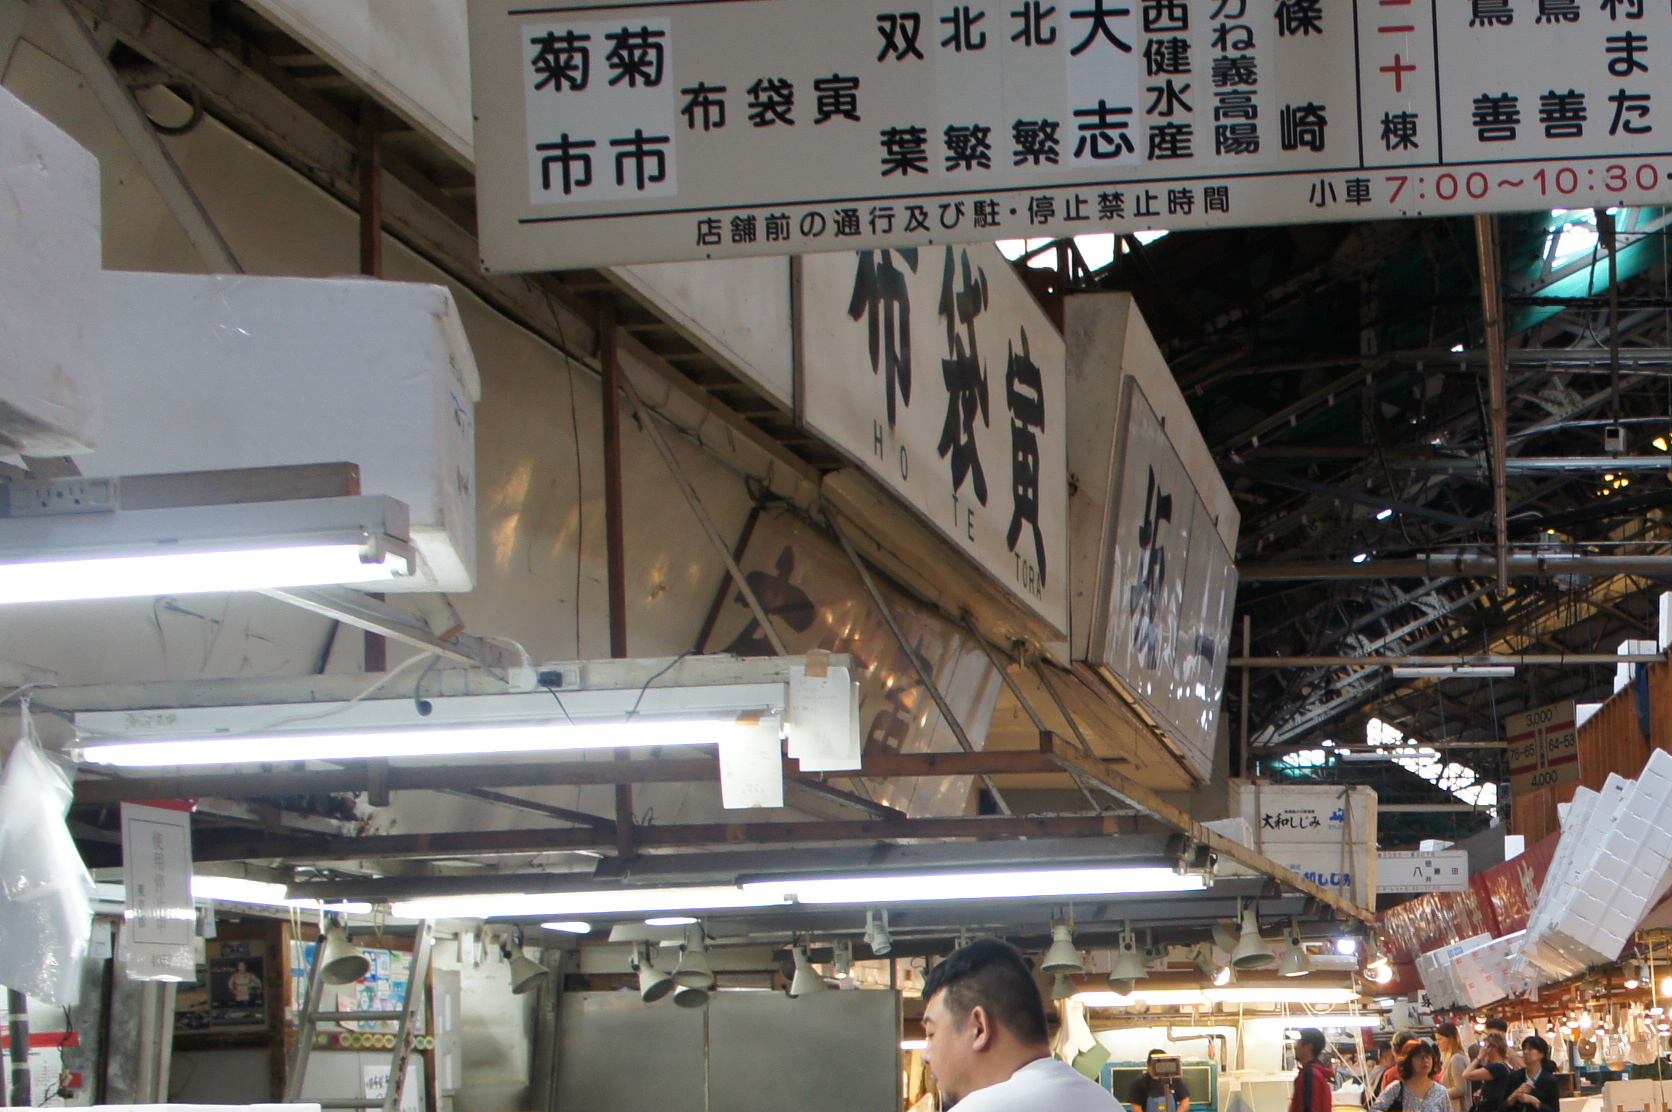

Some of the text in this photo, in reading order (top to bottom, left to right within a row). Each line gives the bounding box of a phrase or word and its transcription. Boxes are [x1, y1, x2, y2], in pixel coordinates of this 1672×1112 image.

[529, 30, 596, 194] 菊市
[604, 26, 671, 190] 菊市
[680, 74, 861, 131] 布袋寅
[876, 12, 930, 176] 双葉
[940, 5, 992, 171] 北繁
[1011, 0, 1061, 165] 北繁
[1069, 0, 1135, 159] 大志
[1261, 812, 1321, 831] 大和しじみ
[1531, 770, 1558, 787] 4,000
